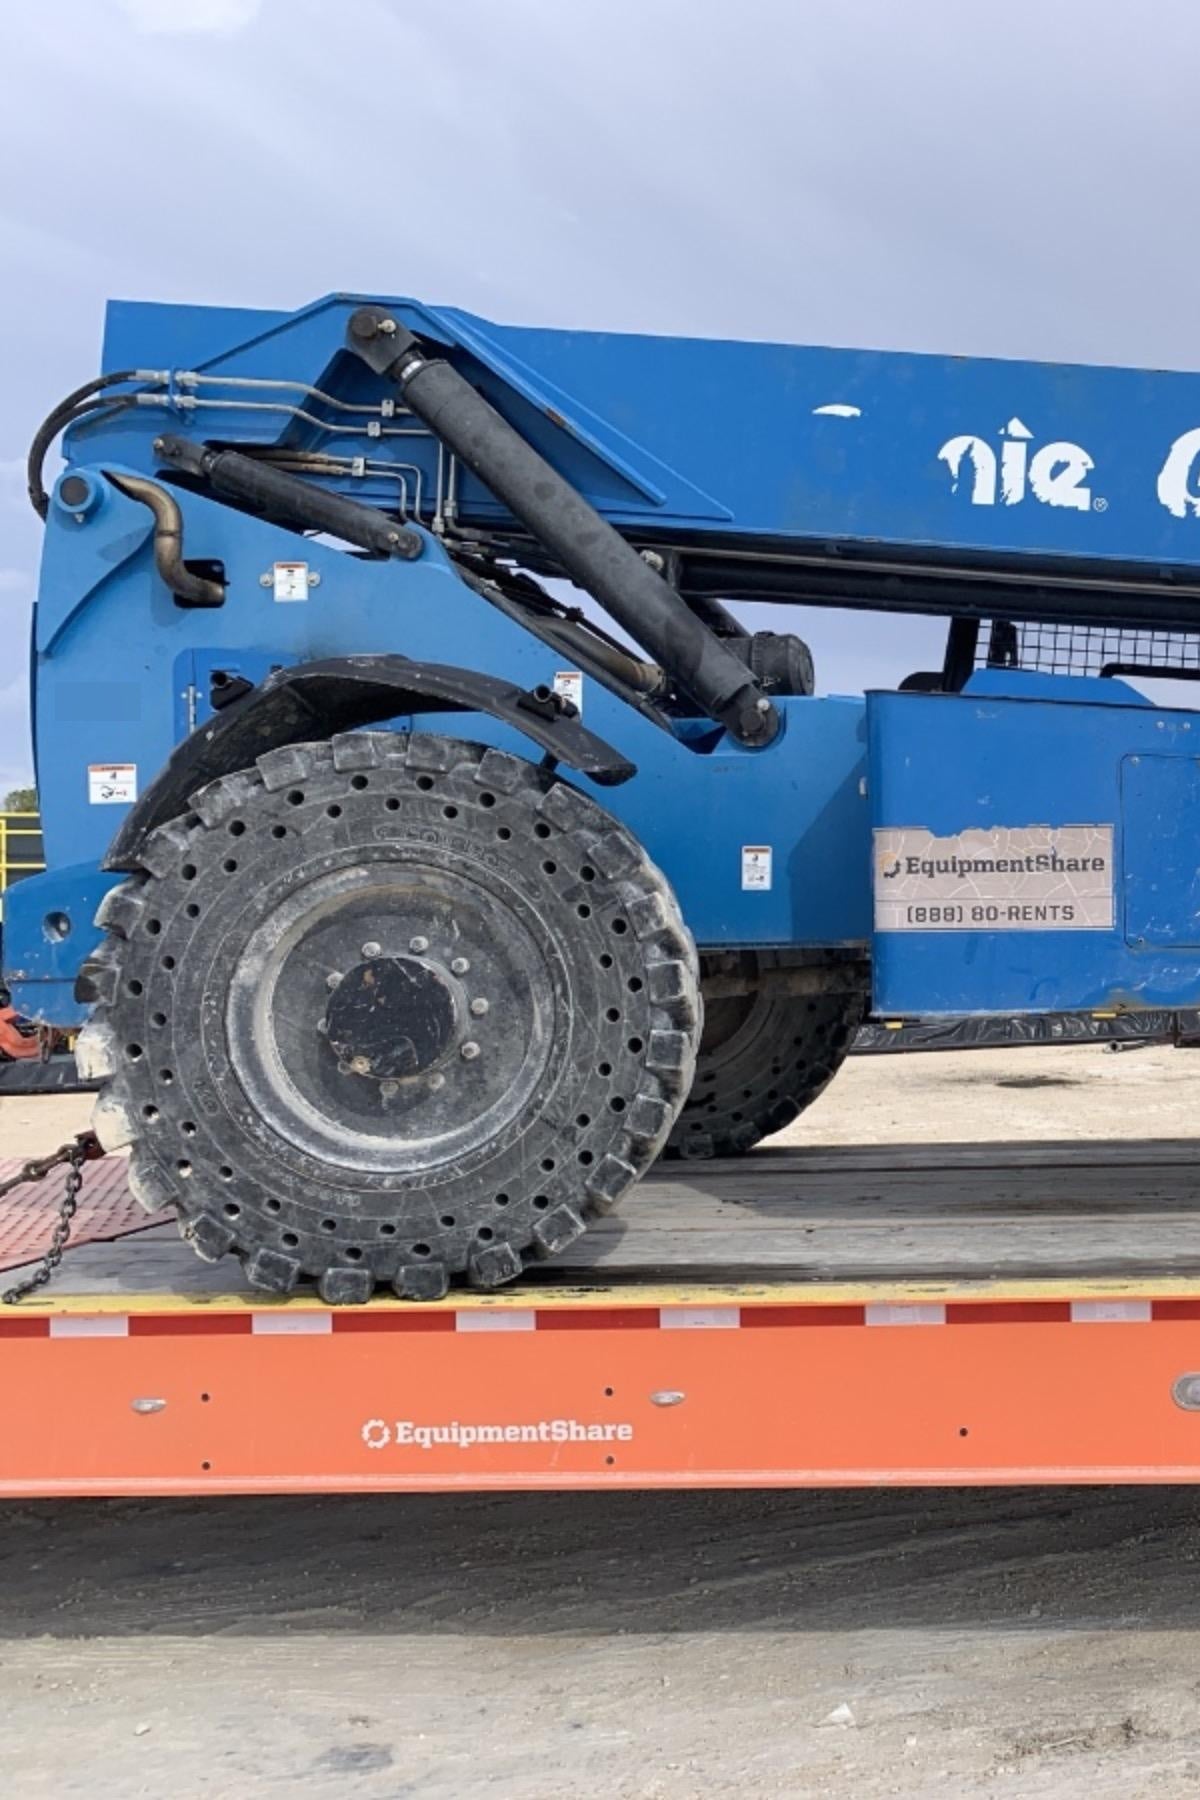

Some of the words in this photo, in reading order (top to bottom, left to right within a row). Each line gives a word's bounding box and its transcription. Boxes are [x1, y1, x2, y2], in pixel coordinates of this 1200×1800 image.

[905, 854, 1105, 878] EquipmentShare
[906, 905, 963, 923] (888)
[971, 905, 1075, 921] 80-RENTS
[396, 1420, 633, 1448] EquipmentShare
